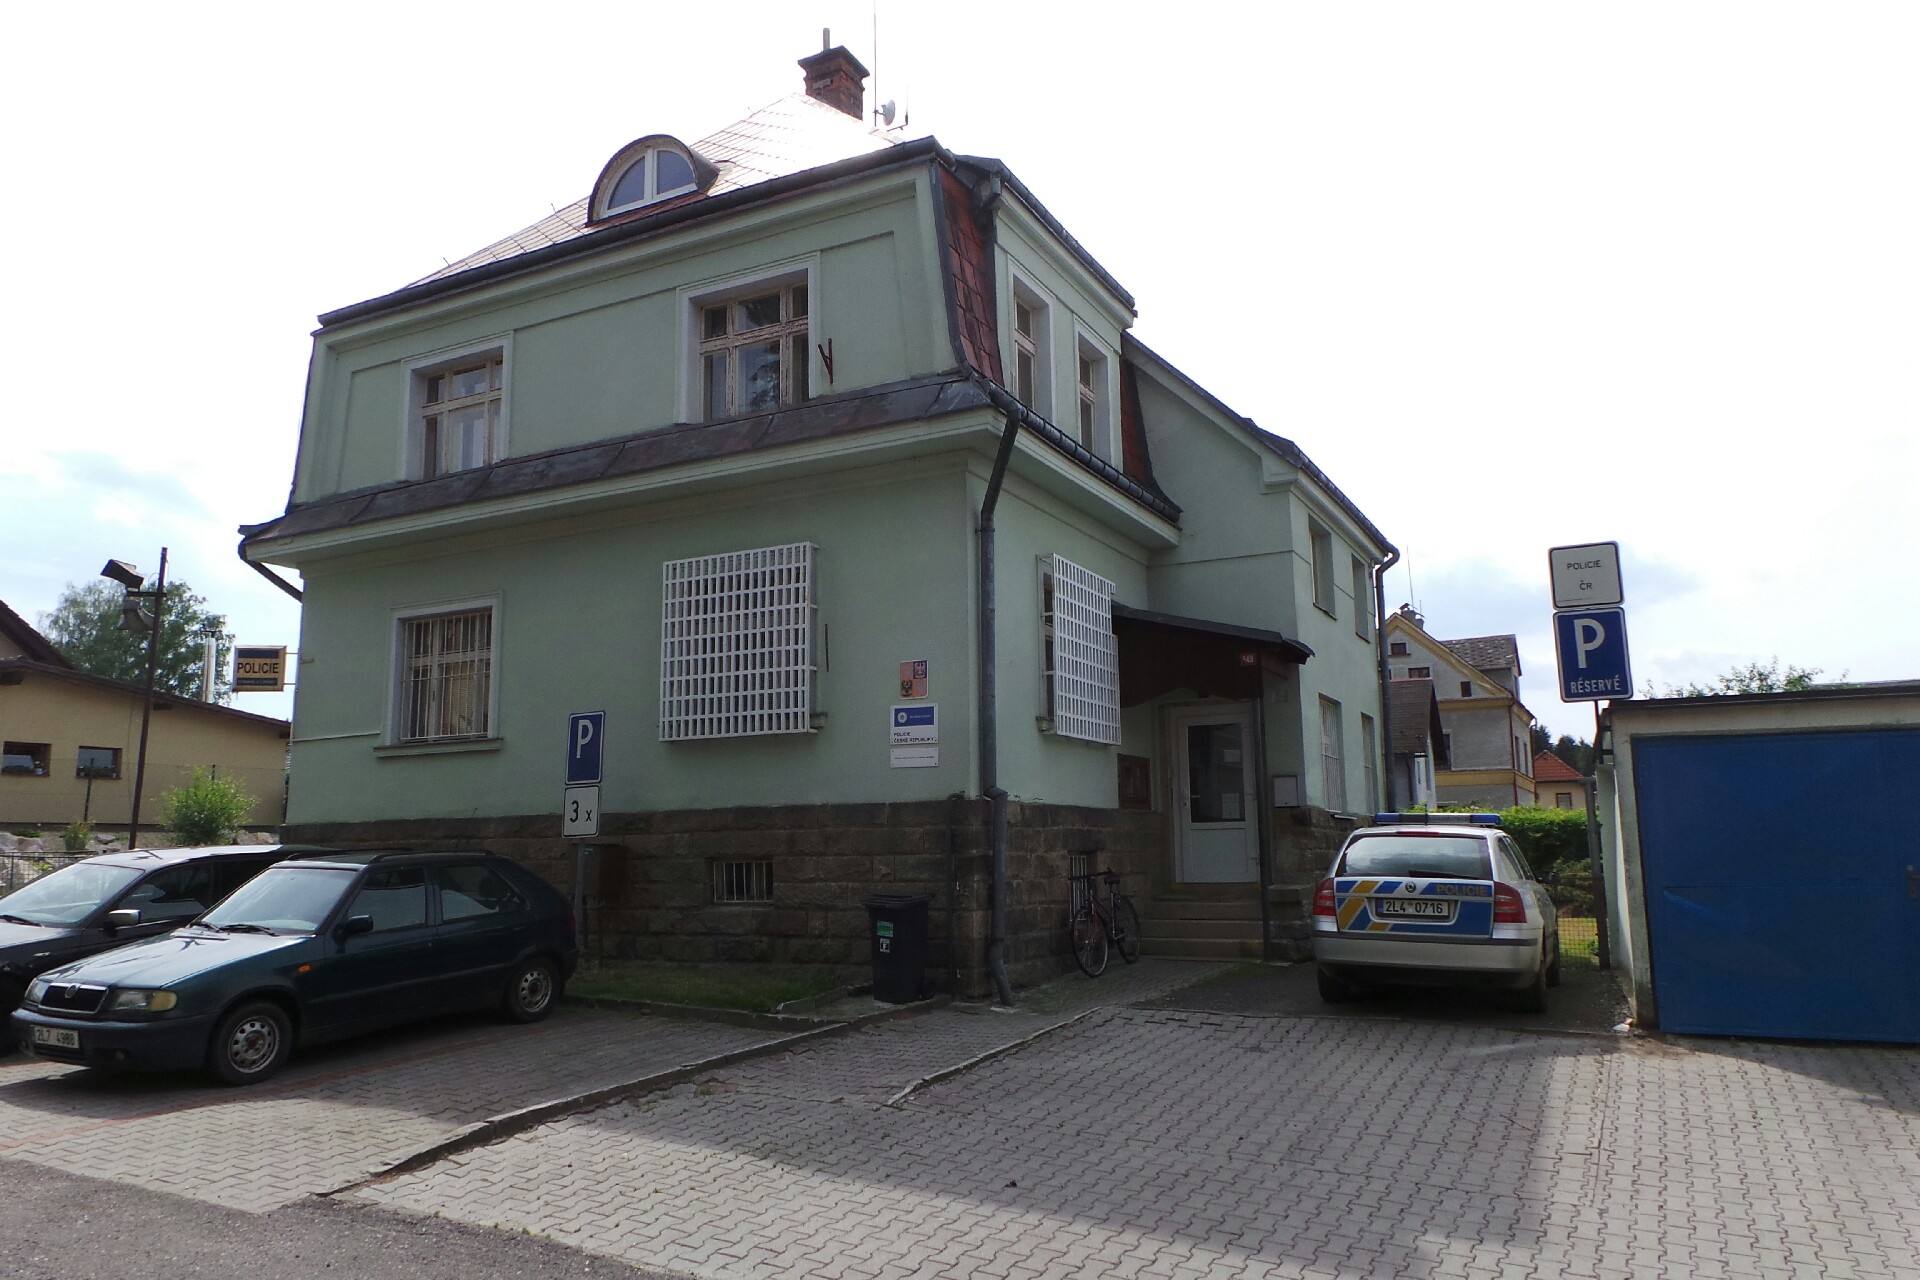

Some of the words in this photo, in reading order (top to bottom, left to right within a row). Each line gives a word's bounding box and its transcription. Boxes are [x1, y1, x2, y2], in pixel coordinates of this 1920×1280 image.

[1566, 560, 1602, 571] POLICIE
[1579, 580, 1593, 591] ČR
[1573, 618, 1606, 669] P
[236, 662, 280, 674] POLICIE
[1570, 674, 1622, 694] RÉSERVÉ
[576, 719, 594, 759] P
[569, 800, 580, 823] 3
[1436, 884, 1489, 897] POLICIE
[1385, 900, 1406, 913] 2L4
[1414, 902, 1444, 914] 0716
